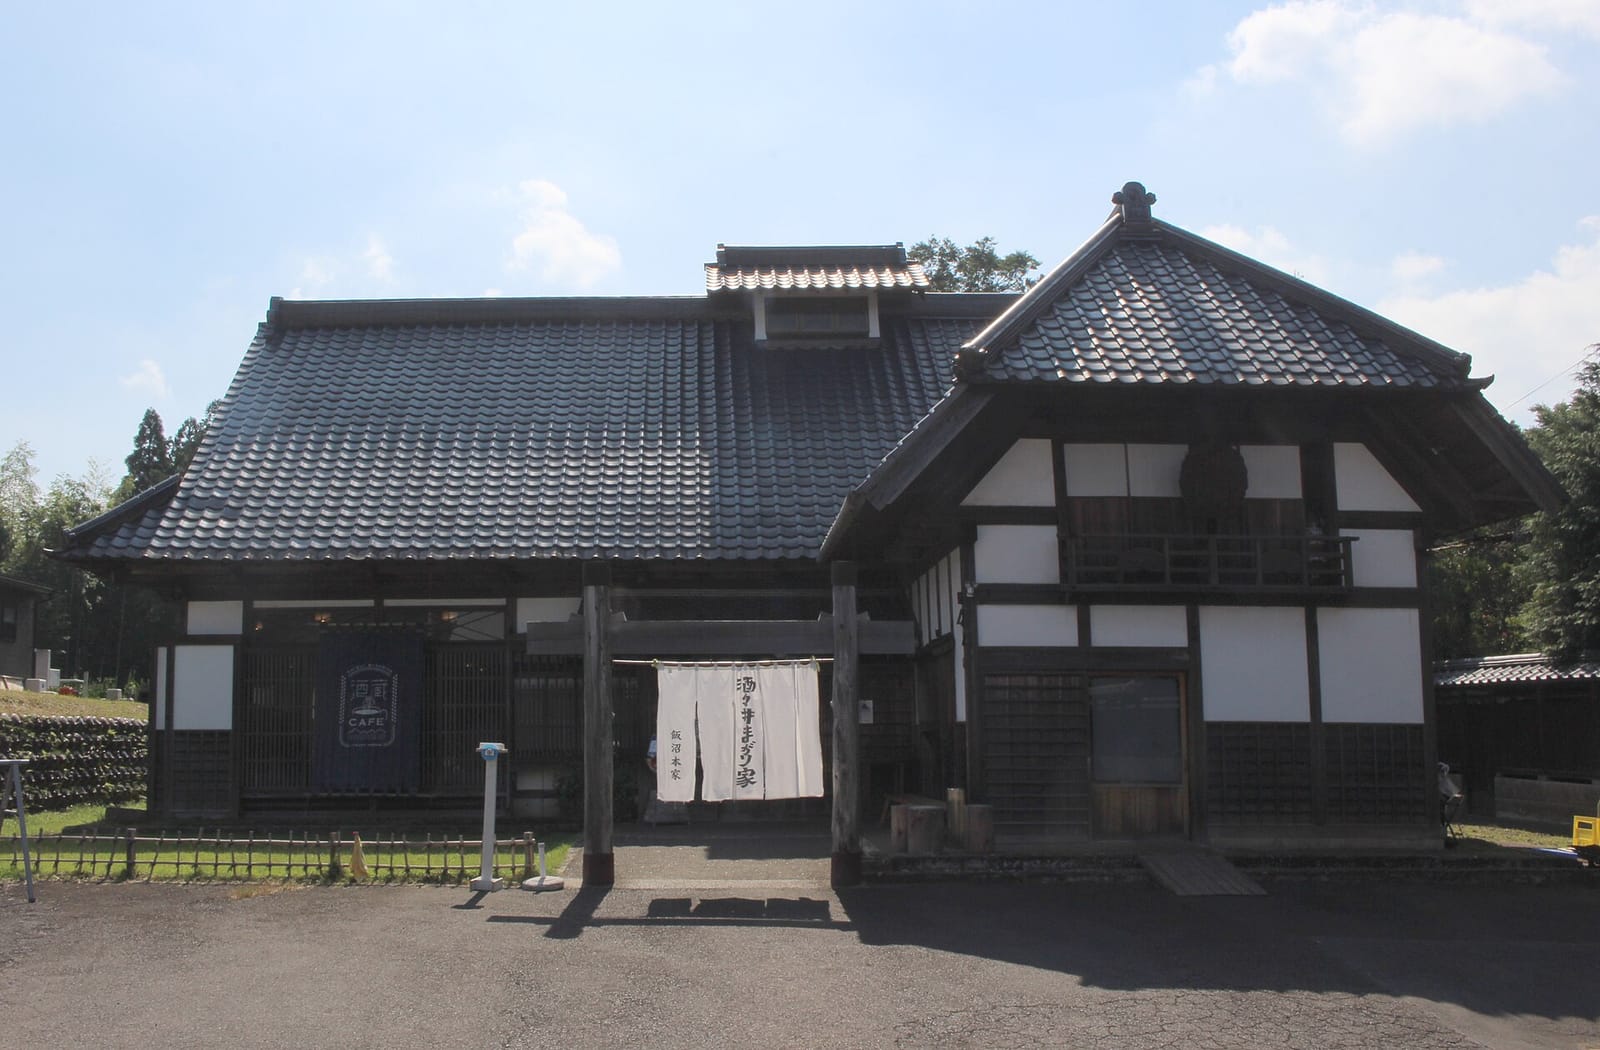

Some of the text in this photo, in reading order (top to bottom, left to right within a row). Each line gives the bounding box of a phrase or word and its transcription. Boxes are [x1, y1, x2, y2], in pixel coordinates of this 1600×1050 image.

[348, 717, 385, 727] CAFE
[736, 676, 757, 788] 酒々井まがり家
[671, 729, 682, 781] 飯沼本家
